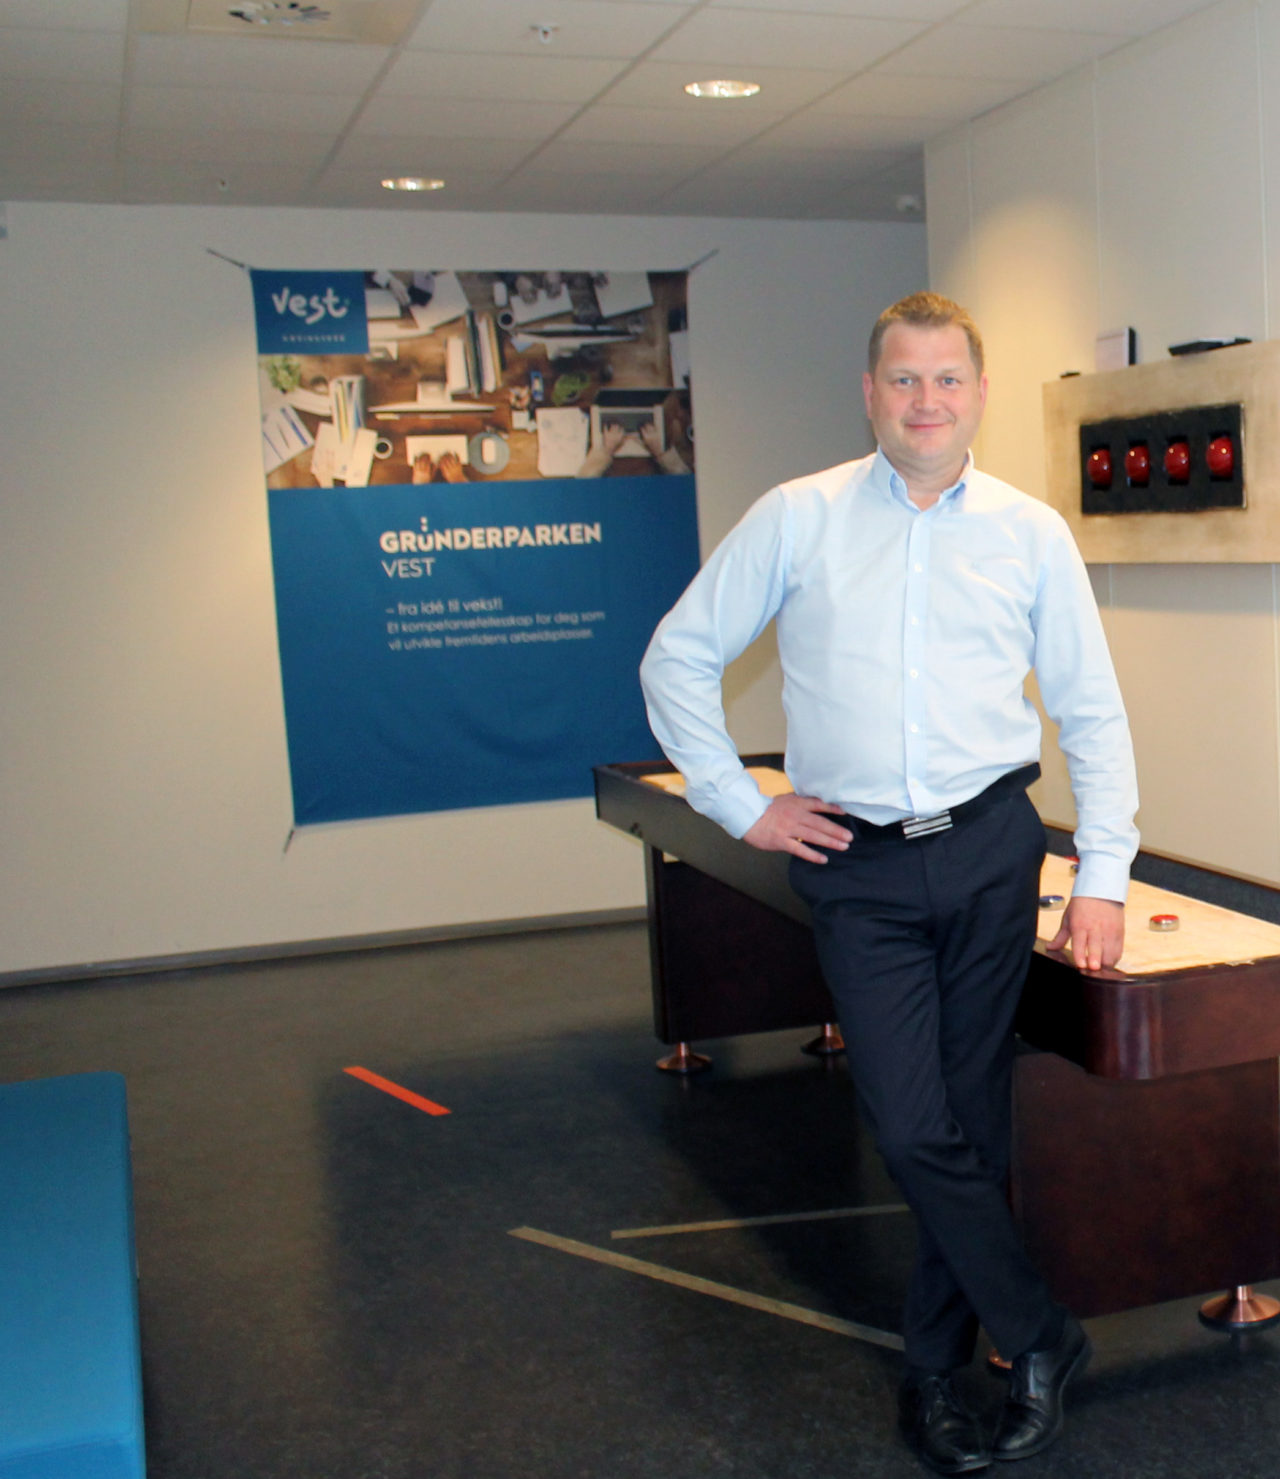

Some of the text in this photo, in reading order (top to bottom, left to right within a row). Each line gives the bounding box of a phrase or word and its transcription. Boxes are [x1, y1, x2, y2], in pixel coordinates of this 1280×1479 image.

[381, 557, 436, 579] VEST
[397, 602, 418, 616] fra
[448, 598, 460, 612] til
[535, 612, 552, 624] for
[553, 611, 579, 626] deg
[580, 611, 606, 623] som
